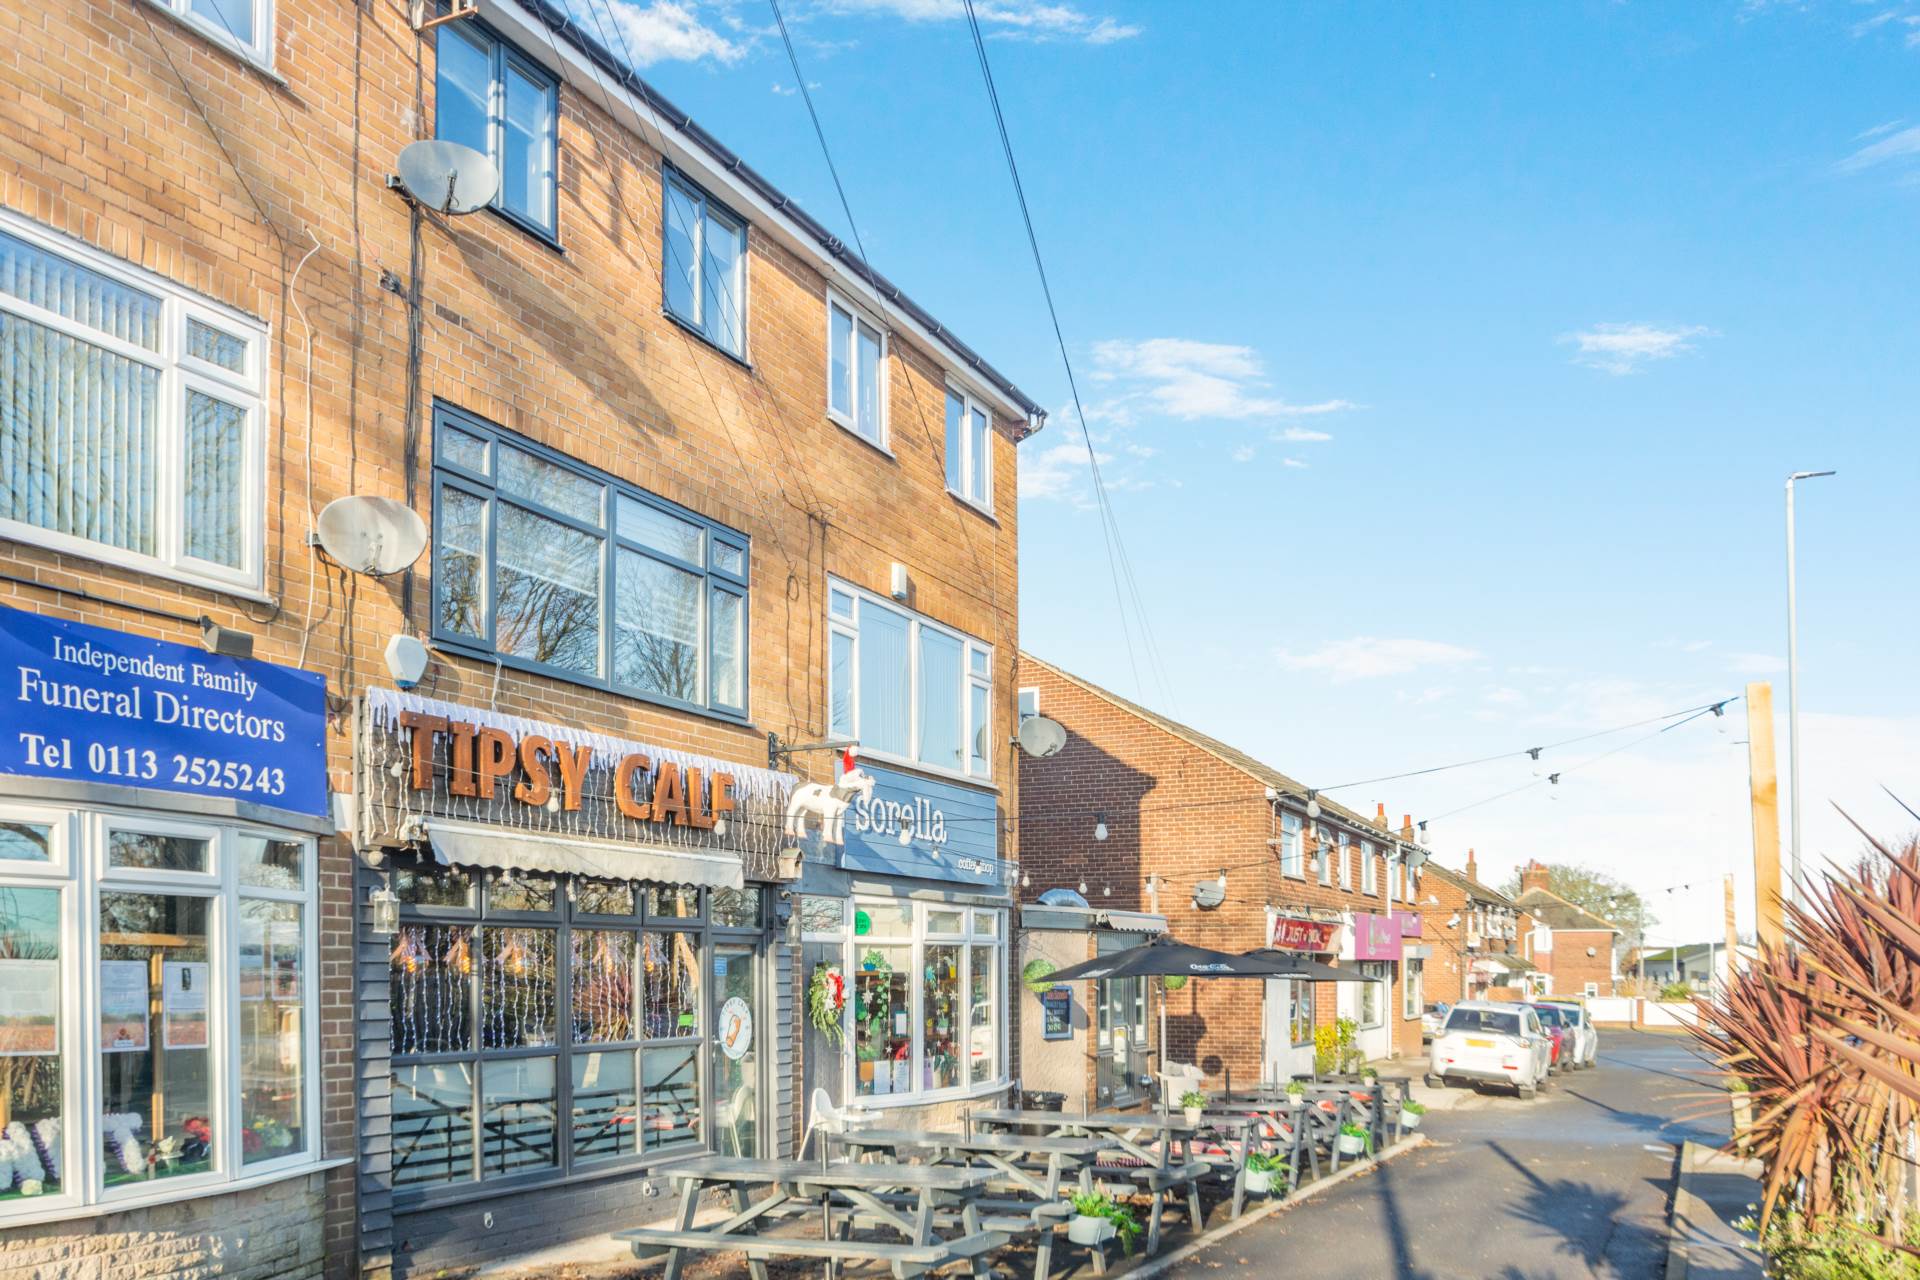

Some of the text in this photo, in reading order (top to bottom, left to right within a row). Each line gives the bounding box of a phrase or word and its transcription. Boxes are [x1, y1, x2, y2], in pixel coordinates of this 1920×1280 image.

[17, 666, 286, 743] Funeral Directors
[53, 636, 258, 702] Independent Family
[19, 733, 286, 796] Tel 0113 2525243
[400, 710, 735, 829] TIPSY CALF
